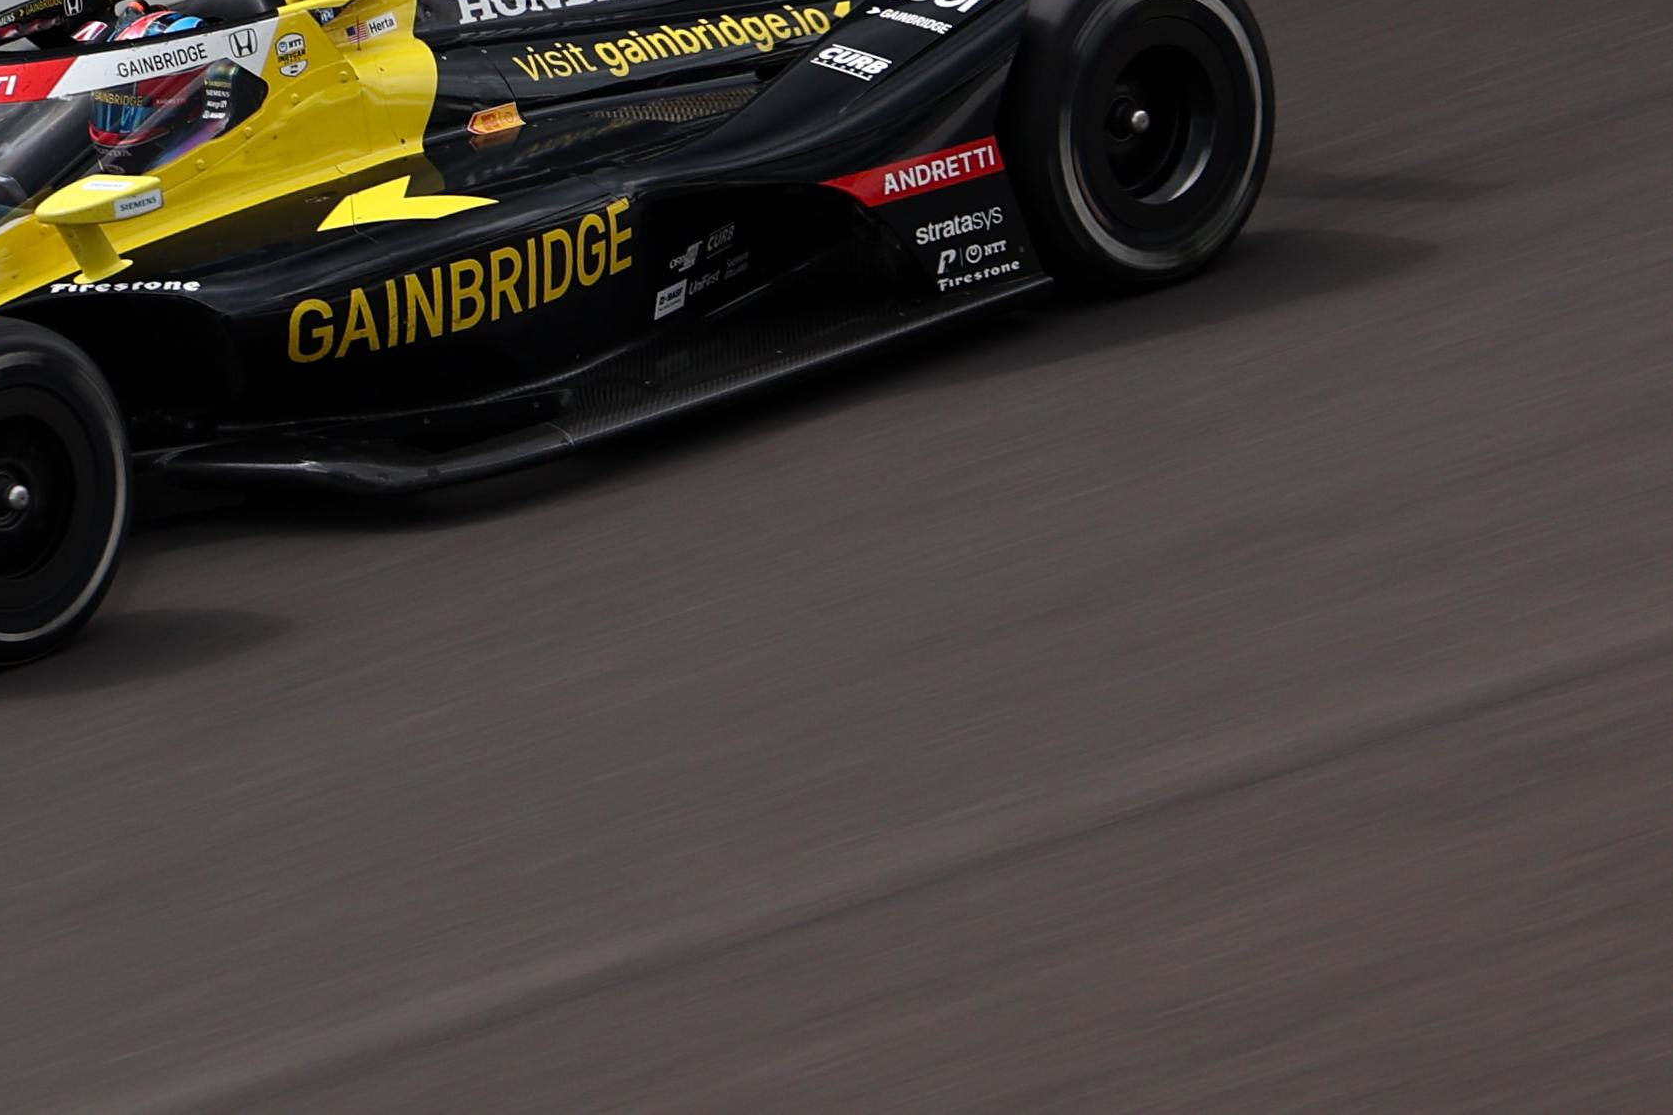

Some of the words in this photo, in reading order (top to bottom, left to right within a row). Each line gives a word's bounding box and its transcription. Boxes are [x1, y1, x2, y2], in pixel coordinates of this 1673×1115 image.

[368, 16, 395, 34] Herta
[879, 8, 953, 35] GAINBRIDGE
[512, 41, 598, 82] visit
[593, 5, 831, 78] gainbridge.io
[116, 42, 208, 78] GAINBRIDGE
[818, 46, 889, 75] CURB
[884, 145, 996, 195] ANDRETTI
[119, 195, 157, 212] SIEMENS
[915, 206, 1003, 245] stratasys
[50, 279, 202, 294] Firestone
[287, 197, 632, 364] GAINBRIDGE
[937, 260, 1021, 292] Firestone
